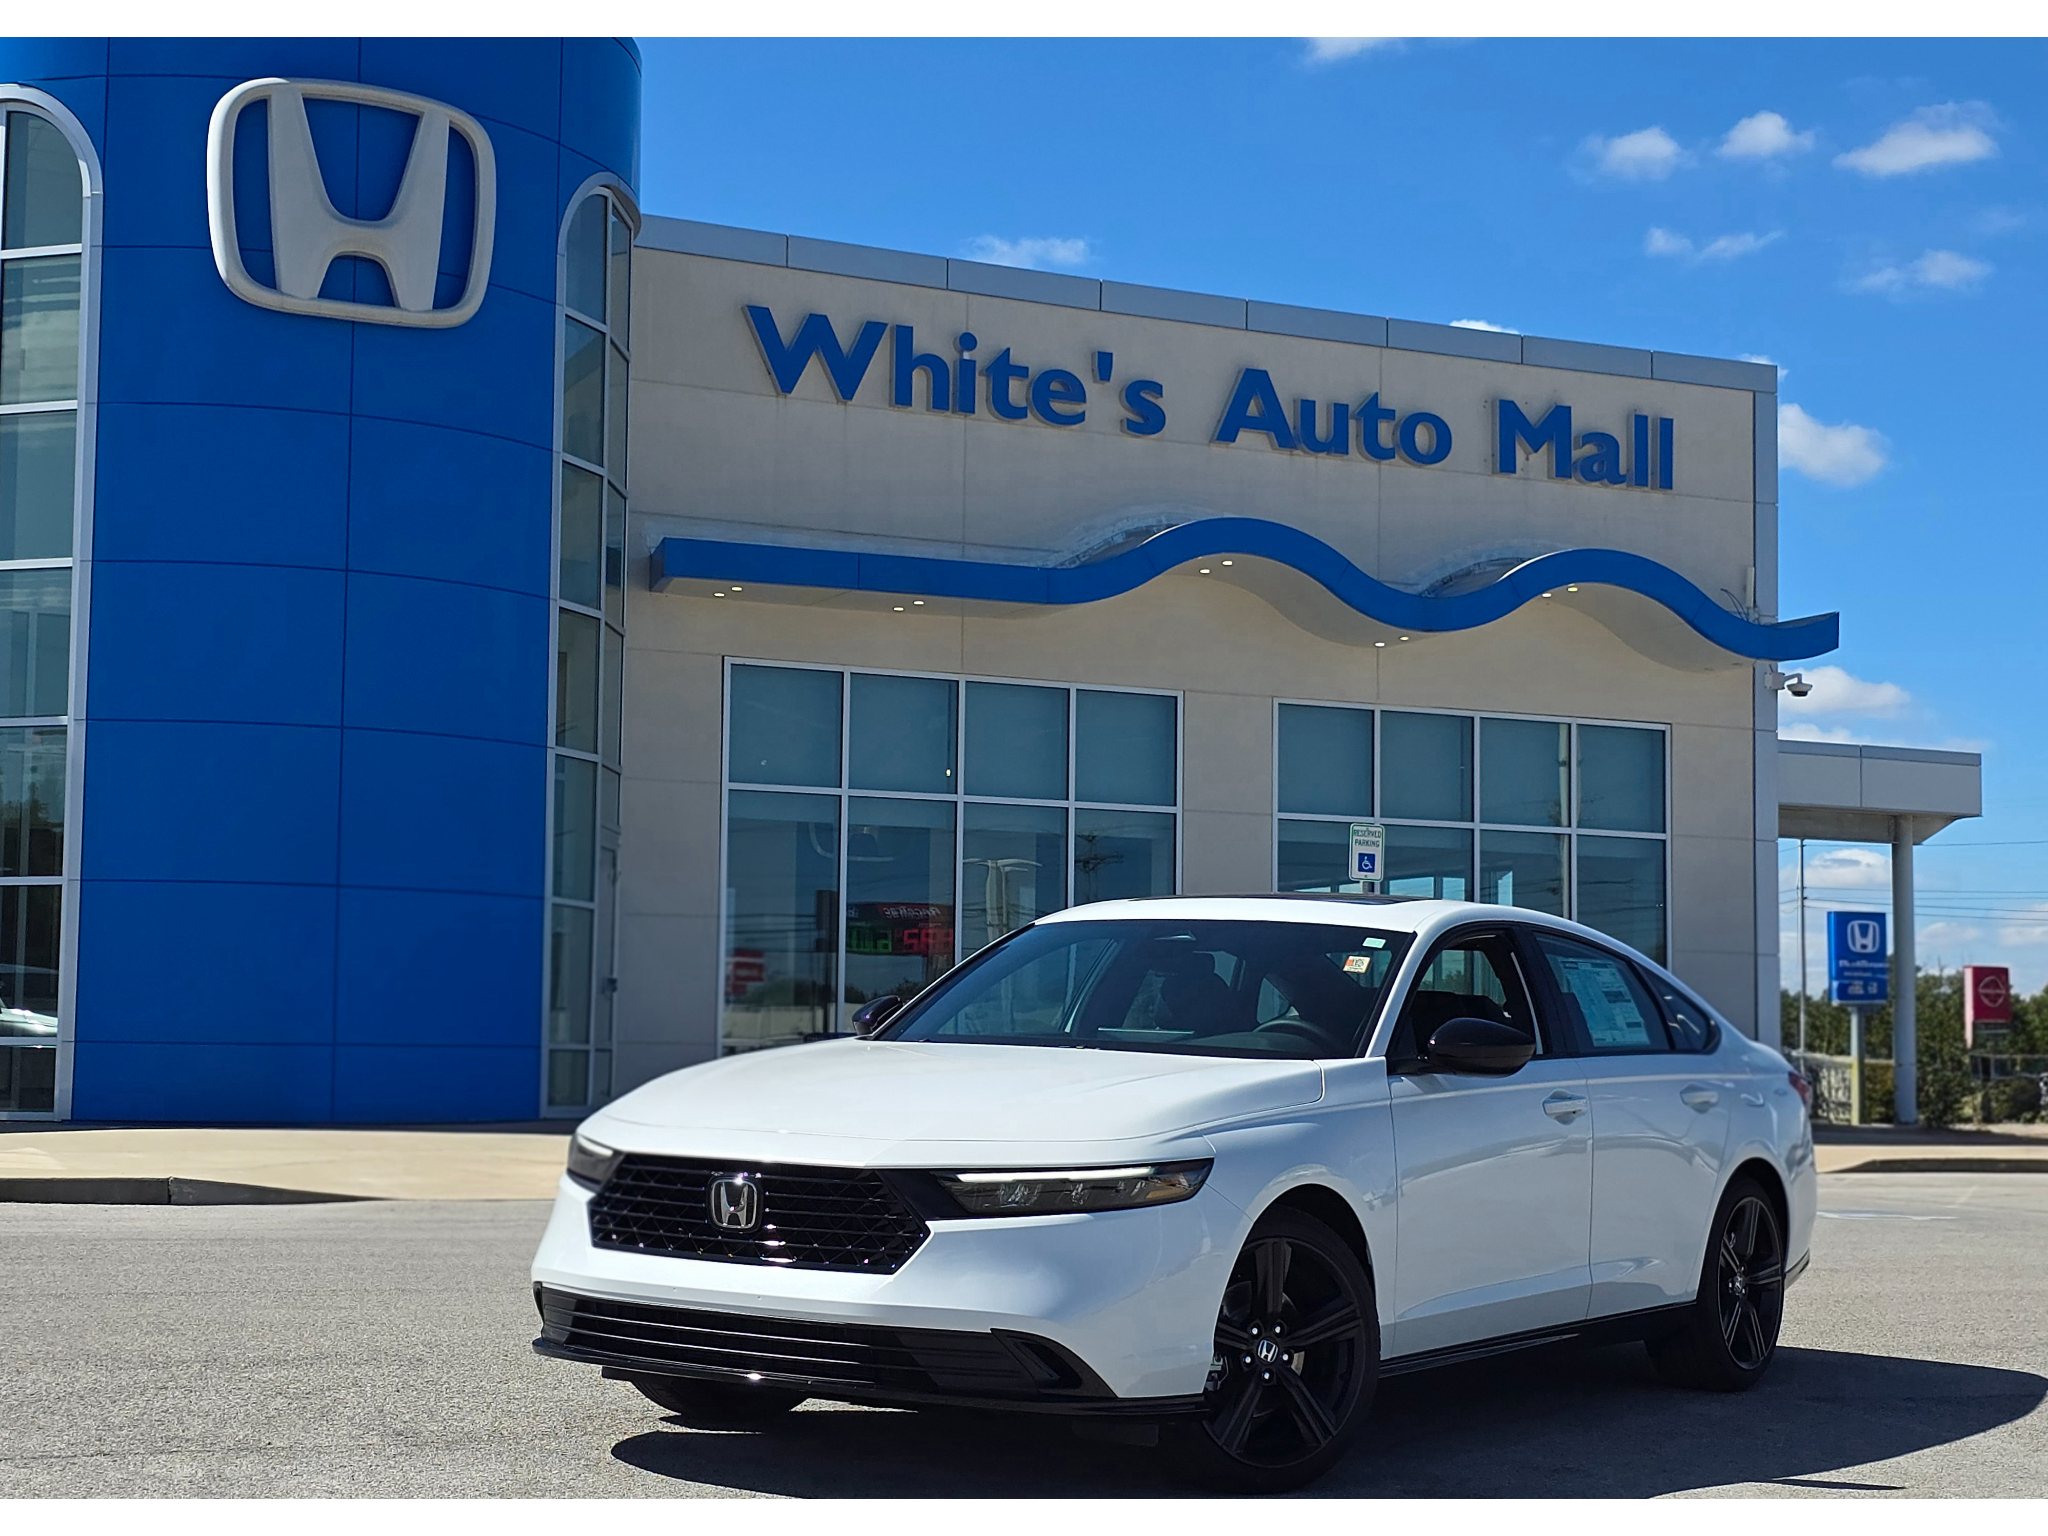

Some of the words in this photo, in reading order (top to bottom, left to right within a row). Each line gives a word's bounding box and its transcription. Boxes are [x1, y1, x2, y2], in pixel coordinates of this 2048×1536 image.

[745, 304, 1166, 435] White's
[1214, 367, 1453, 465] Auto
[1497, 397, 1675, 491] Mall
[1354, 830, 1382, 838] RESERVED
[1355, 839, 1380, 847] PARKING
